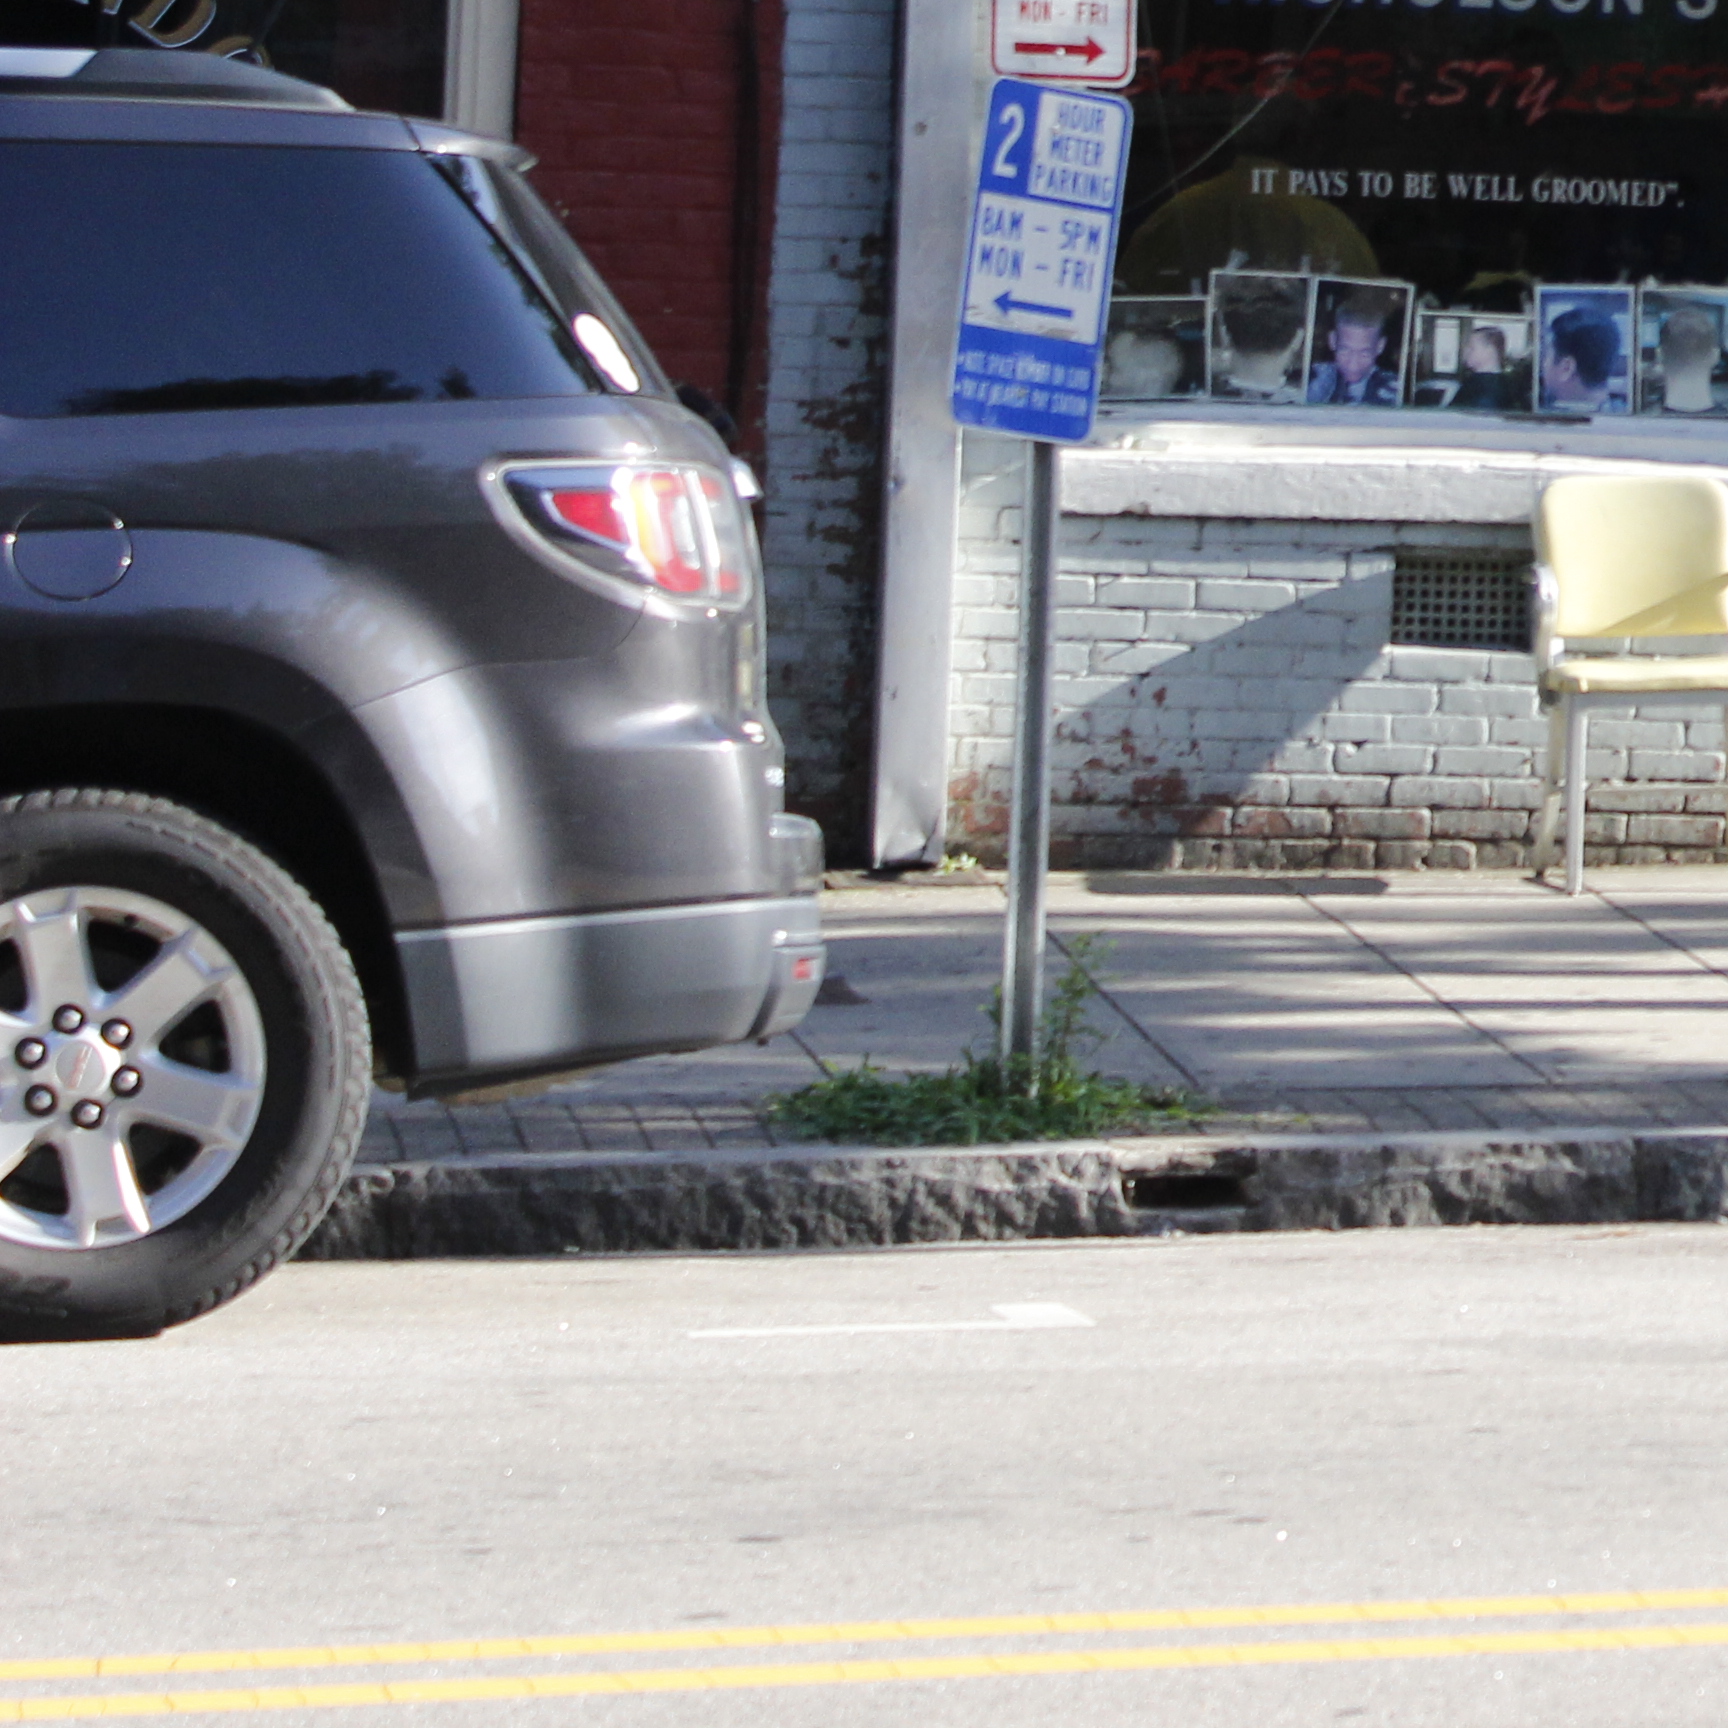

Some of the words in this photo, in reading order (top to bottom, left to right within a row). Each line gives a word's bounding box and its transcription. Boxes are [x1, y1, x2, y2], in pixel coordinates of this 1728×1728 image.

[1018, 0, 1052, 22] MON
[1075, 2, 1109, 26] FRI
[1057, 105, 1106, 134] HOUR
[991, 102, 1026, 179] 2
[1052, 136, 1102, 167] METER
[1034, 163, 1114, 207] PARKING
[1287, 169, 1349, 199] PAYS
[1358, 170, 1394, 199] TO
[1402, 171, 1438, 200] BE
[1446, 173, 1524, 203] WELL
[1060, 219, 1102, 255] 5PM
[980, 244, 1024, 281] MON
[1059, 257, 1097, 292] FRI
